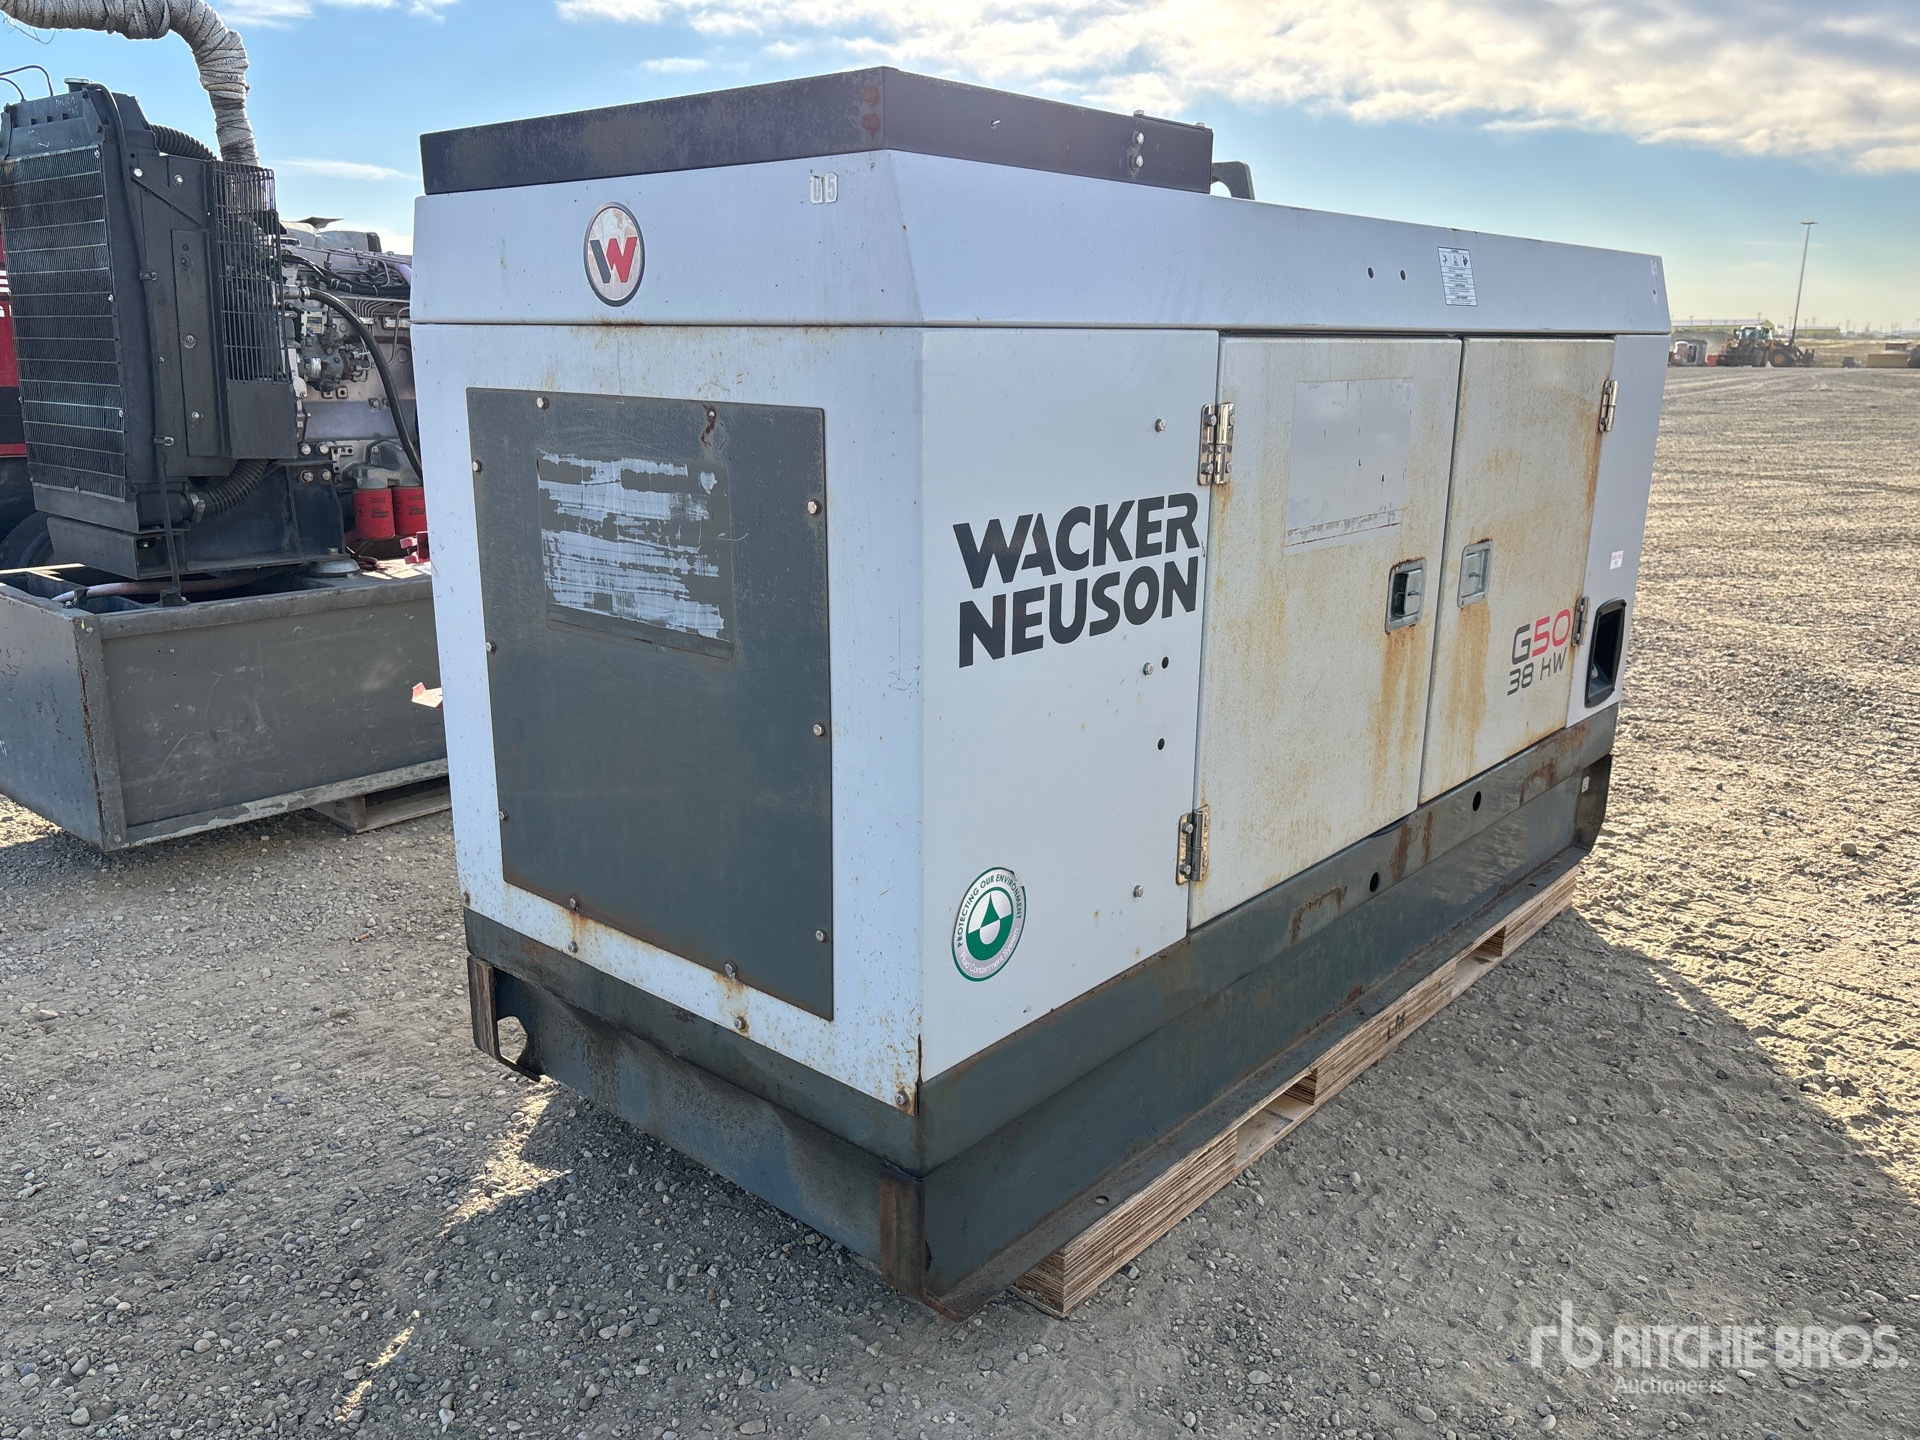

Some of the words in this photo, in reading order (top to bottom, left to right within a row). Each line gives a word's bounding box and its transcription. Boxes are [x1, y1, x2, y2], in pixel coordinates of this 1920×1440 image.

[589, 236, 638, 283] W
[953, 492, 1200, 589] WACKER
[959, 556, 1199, 668] NEUSON
[1512, 609, 1571, 665] G50
[1507, 662, 1534, 696] 38
[1540, 647, 1567, 680] HW
[957, 887, 979, 948] PROTECTING
[980, 875, 995, 889] OUR
[996, 873, 1022, 919] ENVIRONMENT
[960, 952, 970, 969] Fluid
[969, 954, 1004, 974] Containment
[1003, 928, 1019, 957] System
